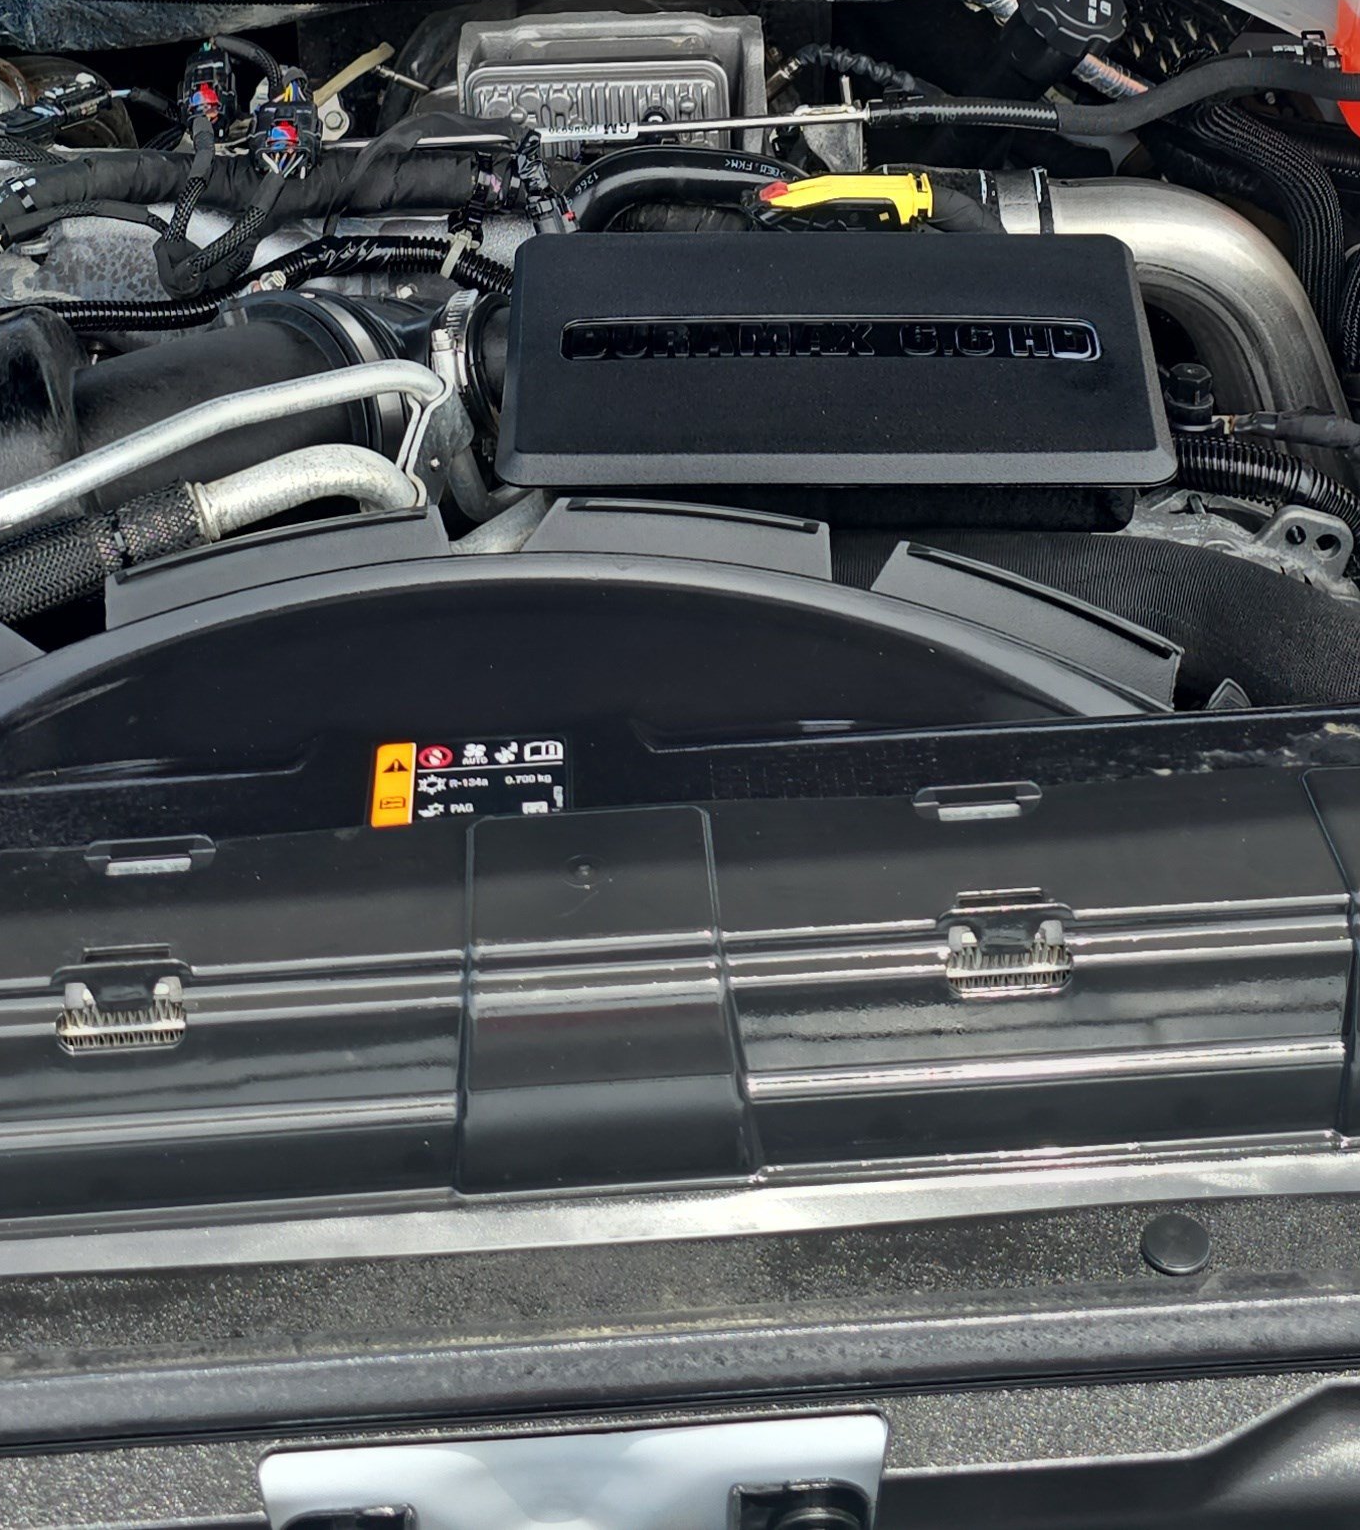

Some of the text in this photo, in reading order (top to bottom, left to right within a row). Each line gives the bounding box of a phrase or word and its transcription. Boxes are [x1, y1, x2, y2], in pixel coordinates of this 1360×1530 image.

[570, 322, 876, 359] DURAMAX
[1010, 322, 1093, 360] HD
[462, 756, 489, 766] AUTO
[449, 777, 489, 788] R-134a
[537, 774, 552, 784] kg
[450, 802, 475, 814] PAG
